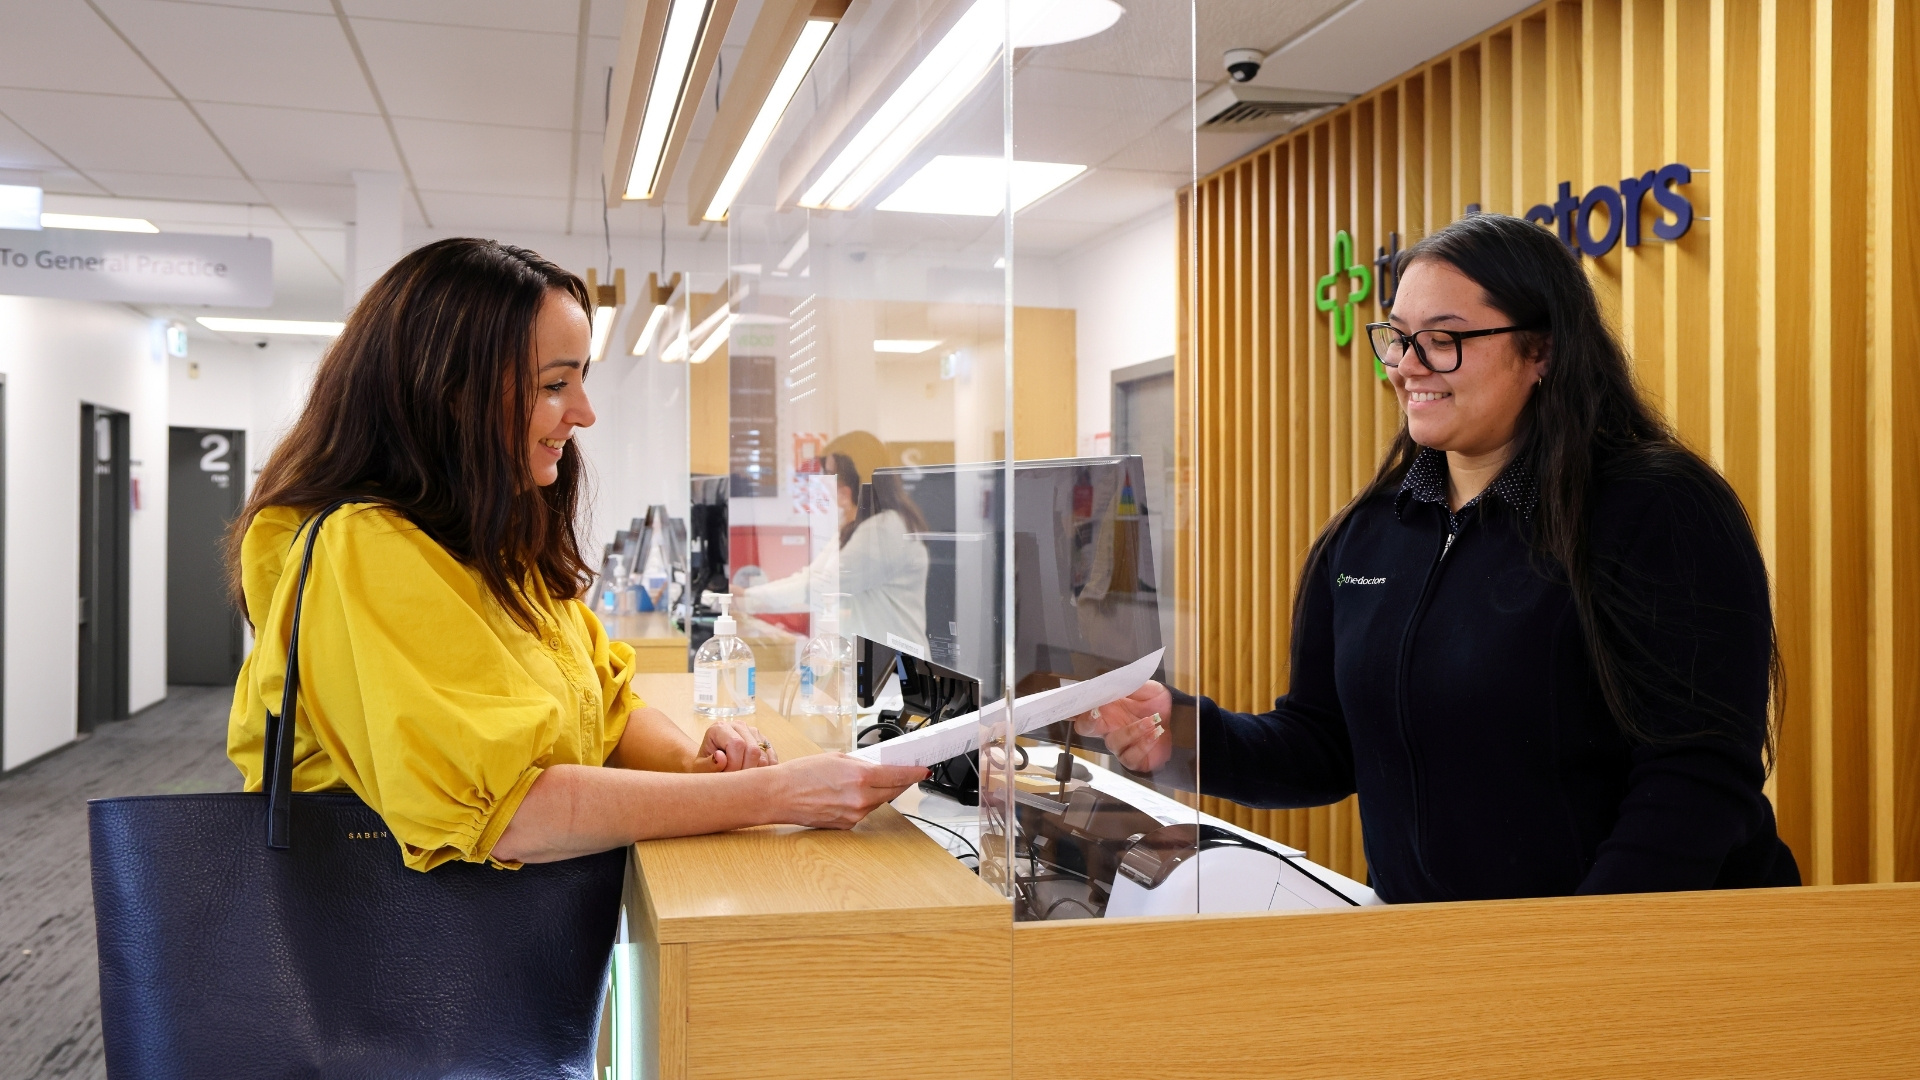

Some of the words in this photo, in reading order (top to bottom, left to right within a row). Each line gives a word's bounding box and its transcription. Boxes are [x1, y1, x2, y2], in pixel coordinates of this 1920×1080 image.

[0, 248, 28, 269] To
[35, 250, 129, 273] General
[137, 253, 228, 278] Practice
[200, 433, 230, 472] 2
[348, 831, 387, 840] SABEN
